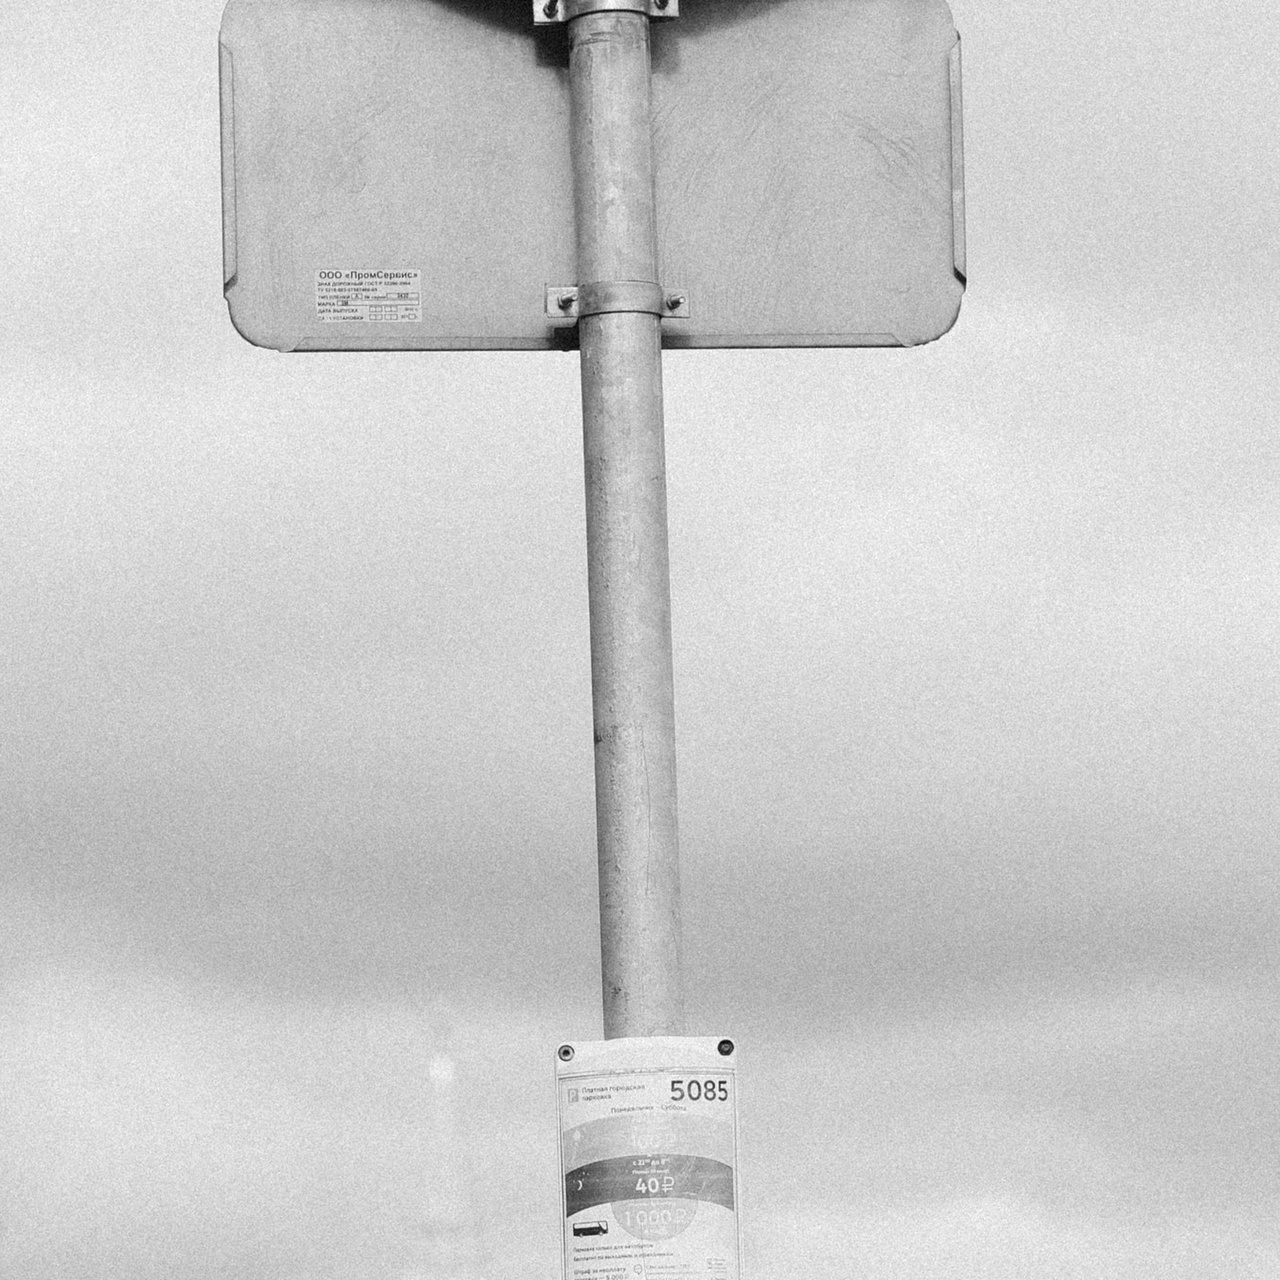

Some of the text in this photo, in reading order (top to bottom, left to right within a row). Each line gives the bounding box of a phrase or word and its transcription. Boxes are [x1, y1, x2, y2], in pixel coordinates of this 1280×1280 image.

[319, 270, 418, 281] ООО «ПромСервис»
[670, 1079, 728, 1102] 5085
[635, 1177, 659, 1194] 40
